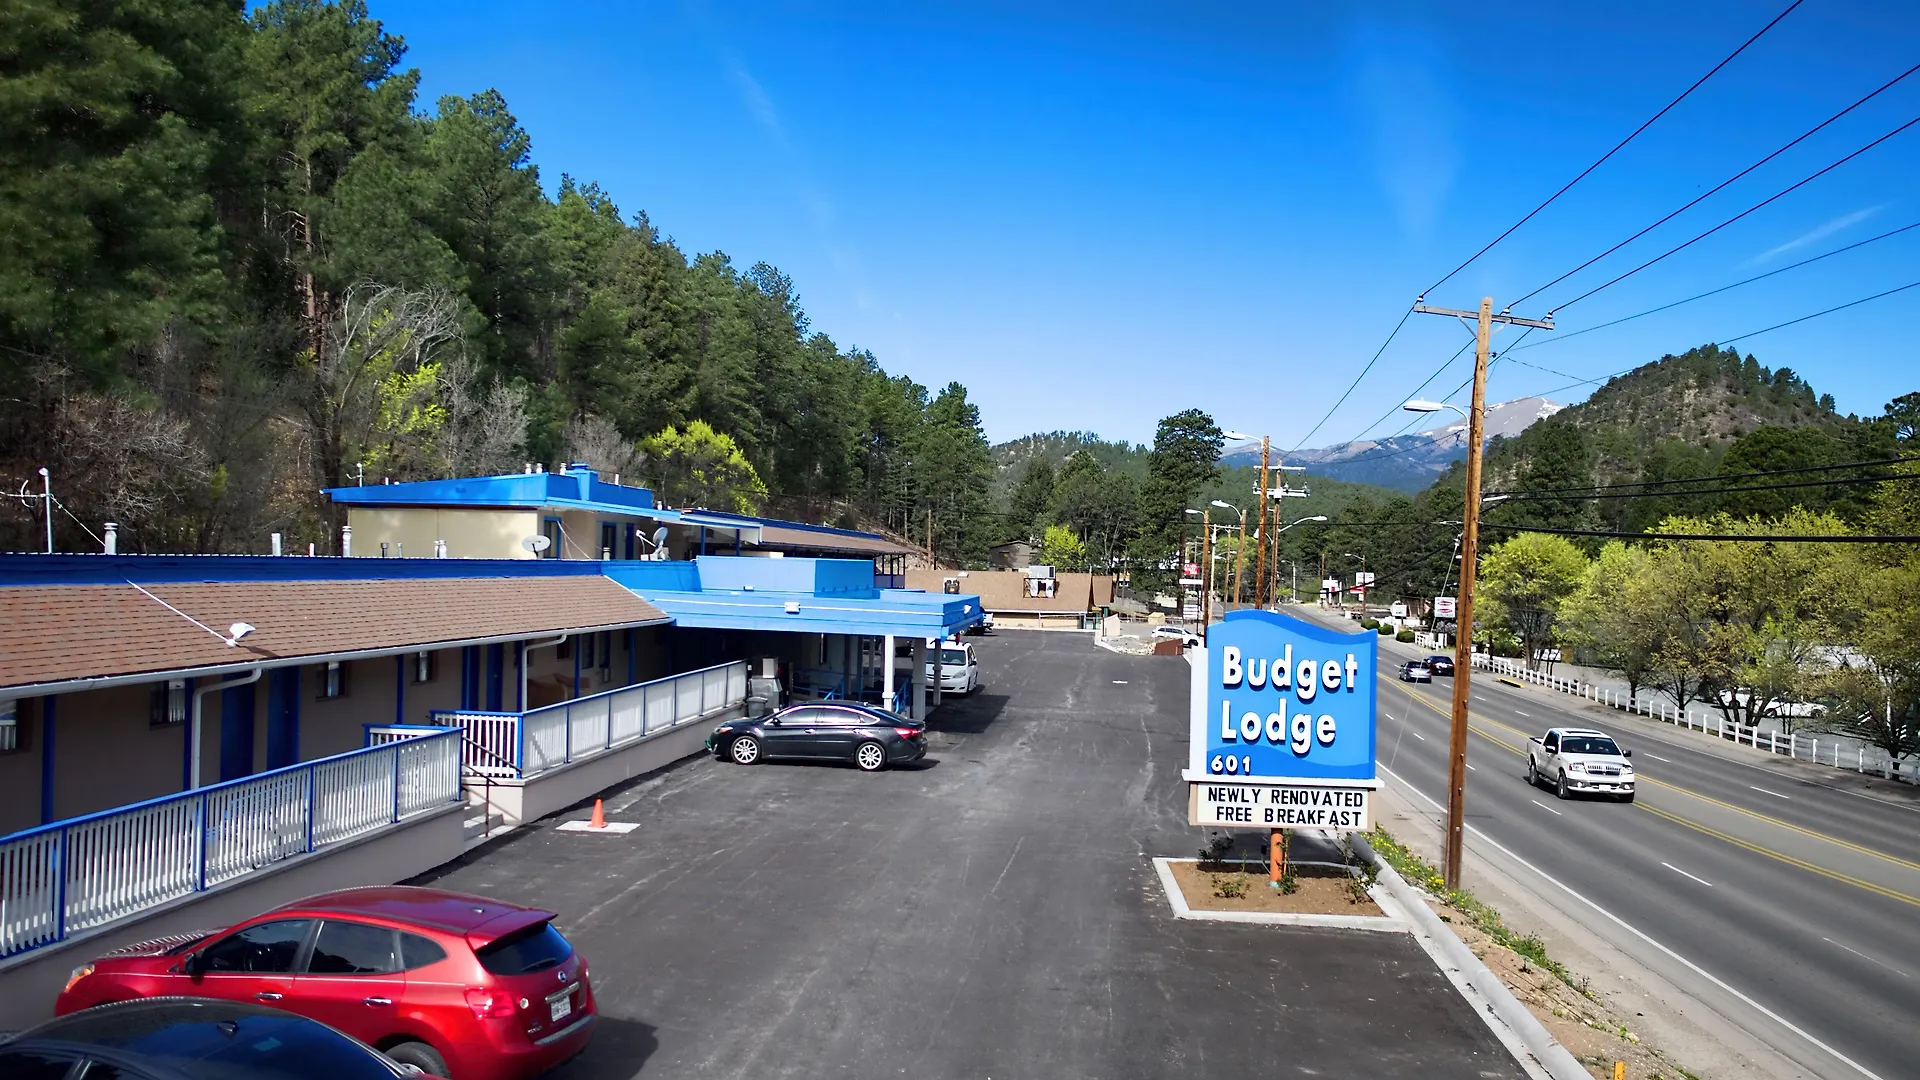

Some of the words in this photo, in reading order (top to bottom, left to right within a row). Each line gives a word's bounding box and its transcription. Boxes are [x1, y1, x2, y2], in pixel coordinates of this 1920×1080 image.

[1223, 644, 1358, 700] Budget
[1221, 698, 1336, 754] Lodge
[1211, 755, 1250, 772] 601
[1208, 787, 1261, 803] NEWLY
[1271, 789, 1363, 807] RENOVATED
[1216, 806, 1252, 822] FREE
[1264, 808, 1361, 826] BREAKFAST
